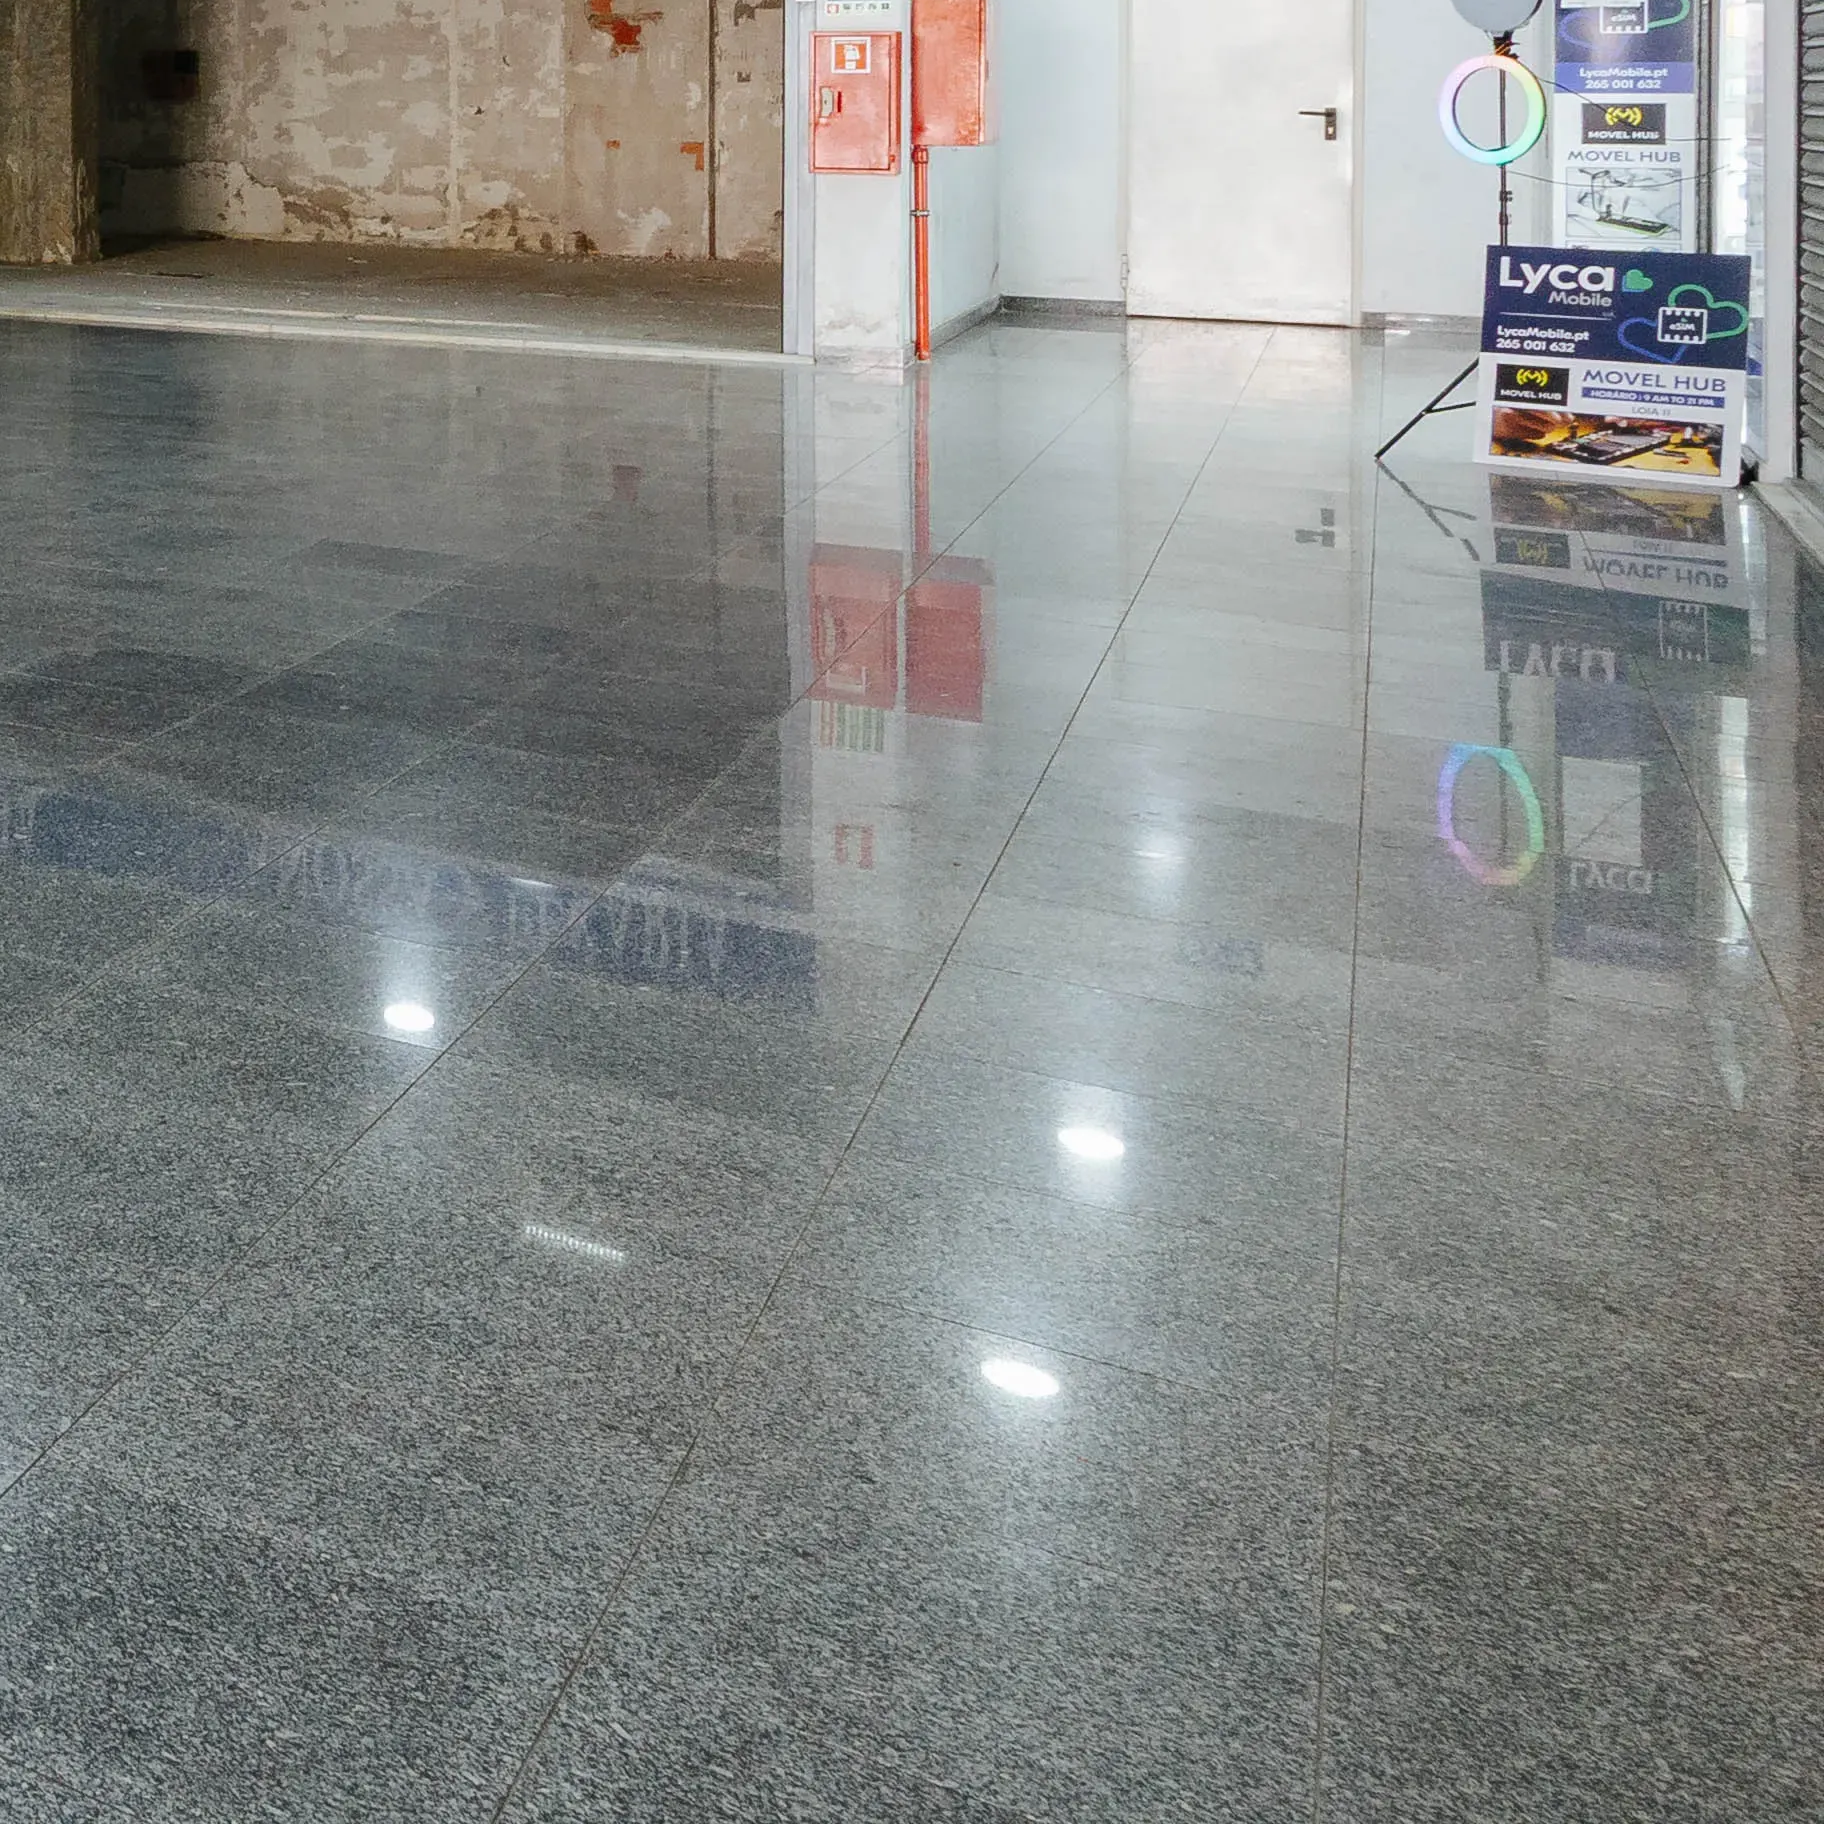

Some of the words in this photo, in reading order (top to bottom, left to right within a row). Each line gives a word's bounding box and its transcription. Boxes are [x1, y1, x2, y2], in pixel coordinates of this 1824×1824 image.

[1579, 67, 1668, 79] LycaMobile.pt
[1585, 80, 1609, 89] 265
[1612, 80, 1634, 89] 001
[1637, 80, 1661, 89] 632
[1587, 130, 1631, 140] MOVEL
[1567, 150, 1634, 162] MOVEL
[1639, 151, 1681, 163] HUB
[1499, 256, 1616, 294] Lyca
[1548, 291, 1612, 307] Mobile
[1497, 325, 1590, 342] LycaMobile.pt
[1496, 338, 1521, 350] 265
[1523, 340, 1546, 351] 001
[1549, 342, 1576, 353] 632
[1582, 369, 1667, 388] MOVEL
[1674, 376, 1727, 392] HUB
[1500, 389, 1537, 399] MOVEL
[1538, 392, 1562, 401] HUB
[1652, 395, 1669, 403] AM
[1697, 397, 1715, 406] PM
